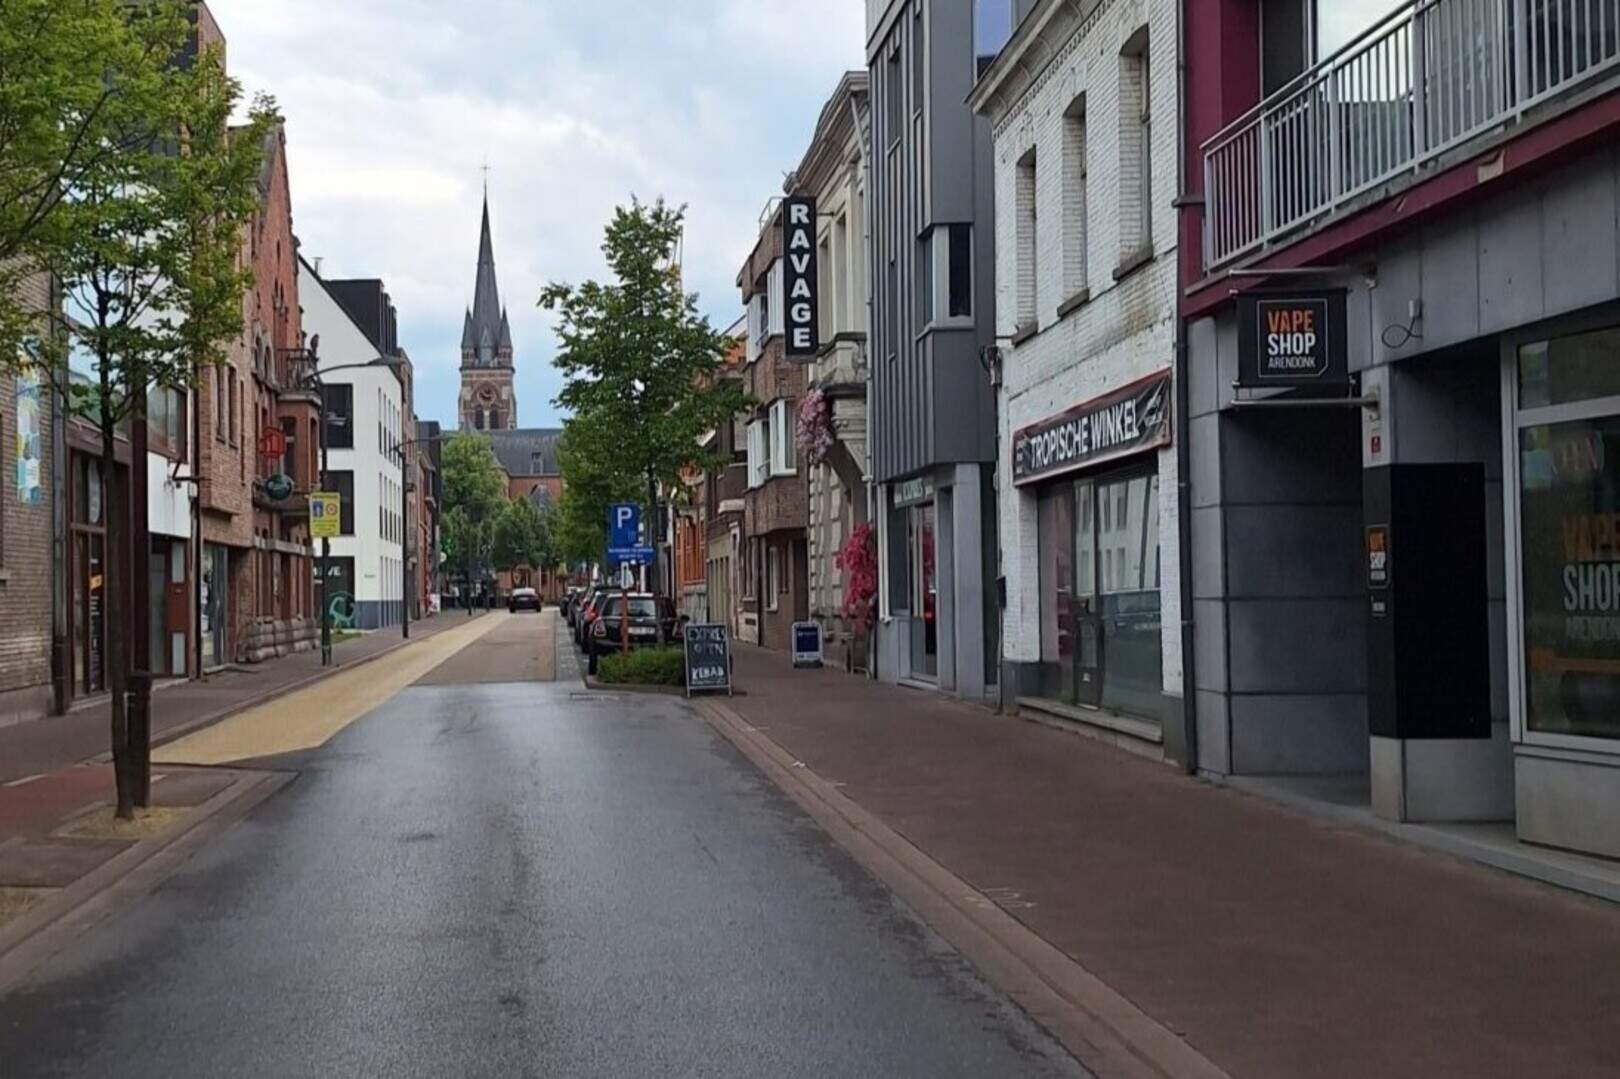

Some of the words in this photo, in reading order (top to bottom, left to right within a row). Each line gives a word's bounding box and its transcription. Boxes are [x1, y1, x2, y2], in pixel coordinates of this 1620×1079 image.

[790, 203, 811, 348] RAVAGE
[1267, 310, 1314, 333] VAPE
[1267, 332, 1316, 356] SHOP
[1268, 356, 1316, 369] ARENDONK
[1031, 417, 1089, 467] TROPISCHE
[1091, 399, 1139, 448] WINKEL
[617, 506, 632, 529] P
